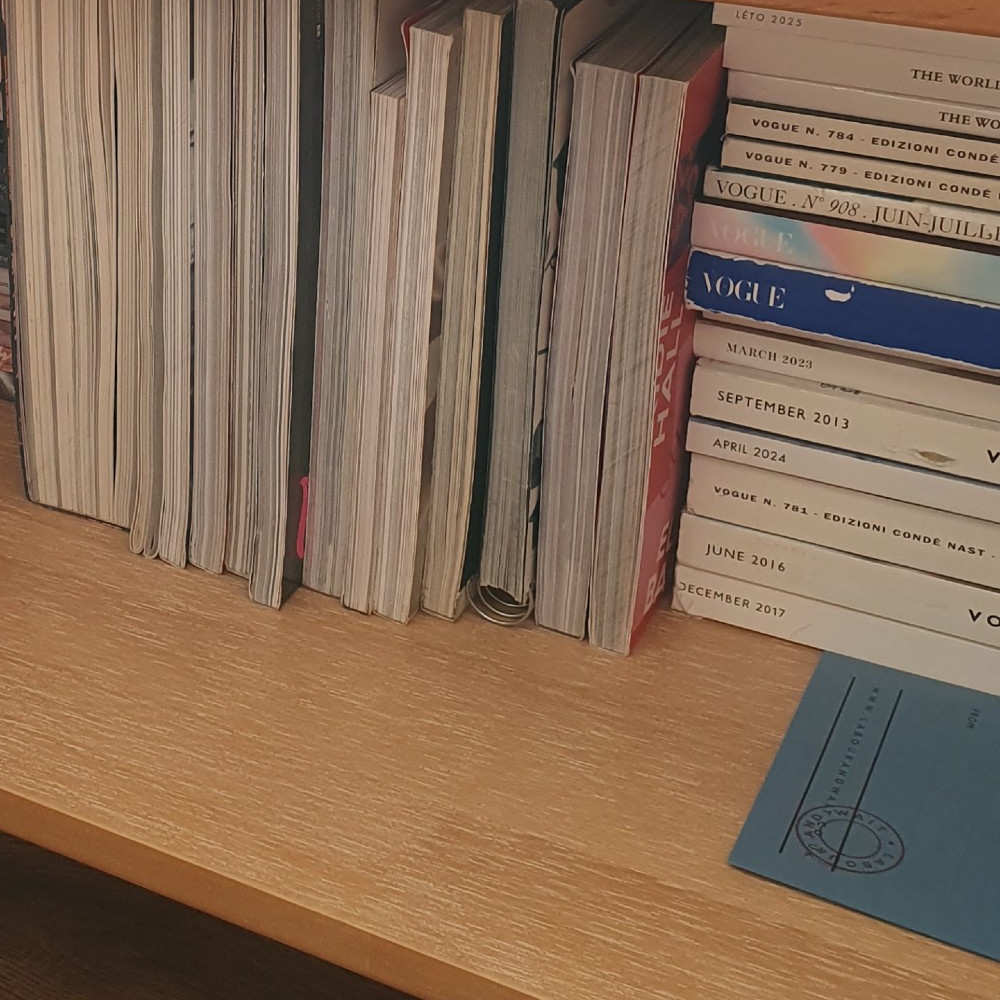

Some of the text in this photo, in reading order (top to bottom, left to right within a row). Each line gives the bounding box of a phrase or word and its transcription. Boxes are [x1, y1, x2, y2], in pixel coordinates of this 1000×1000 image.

[736, 10, 802, 27] LÉTO 2025
[911, 69, 943, 82] THE
[752, 119, 999, 163] VOGUE N. 784 EDIZIONI CONDÉ
[746, 152, 991, 198] VOGUE N. 779 EDIZIONI CONDÉ
[717, 179, 787, 206] VOGUE
[829, 198, 860, 218] 908
[708, 221, 793, 255] VOGUE
[704, 273, 785, 308] VOGUE
[728, 343, 812, 369] MARCH 2023
[717, 391, 849, 429] SEPTEMBER 2013
[713, 438, 785, 462] APRIL 2024
[714, 486, 985, 556] VOGUE N. 781 EDIZIONI CONDÉ NAST
[705, 544, 785, 572] JUNE 2016
[755, 603, 785, 617] 2017
[967, 708, 981, 729] FROM
